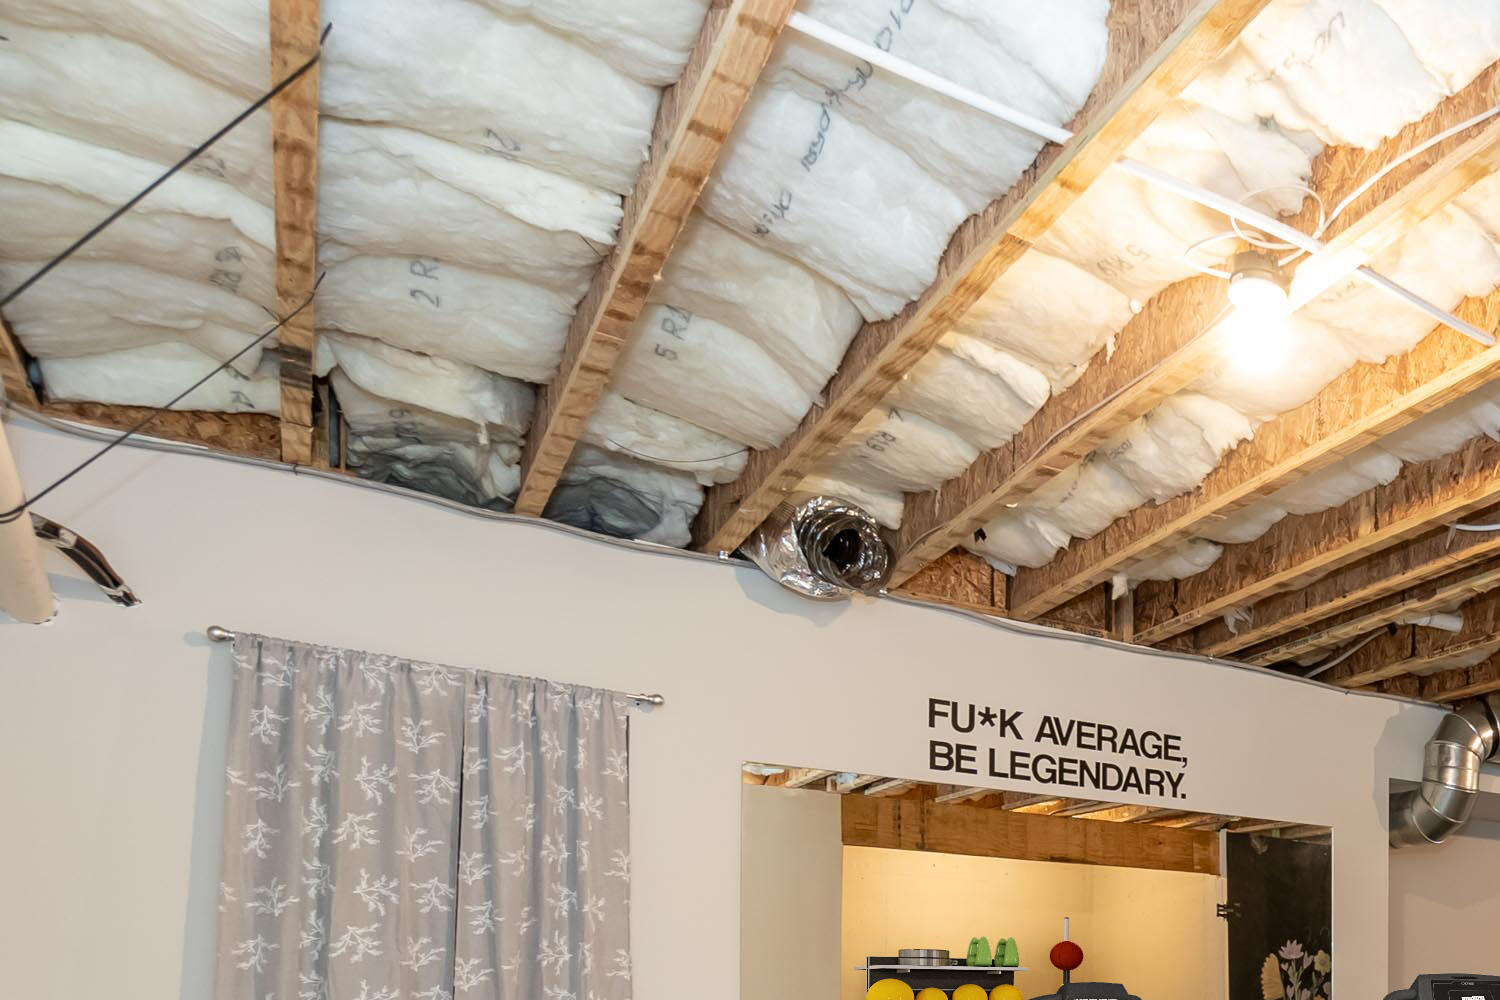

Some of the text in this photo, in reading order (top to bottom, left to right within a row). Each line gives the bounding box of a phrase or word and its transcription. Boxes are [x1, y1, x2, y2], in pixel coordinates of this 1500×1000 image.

[929, 740, 1188, 799] BE LEGENDARY.
[1034, 715, 1189, 769] AVERAGE,
